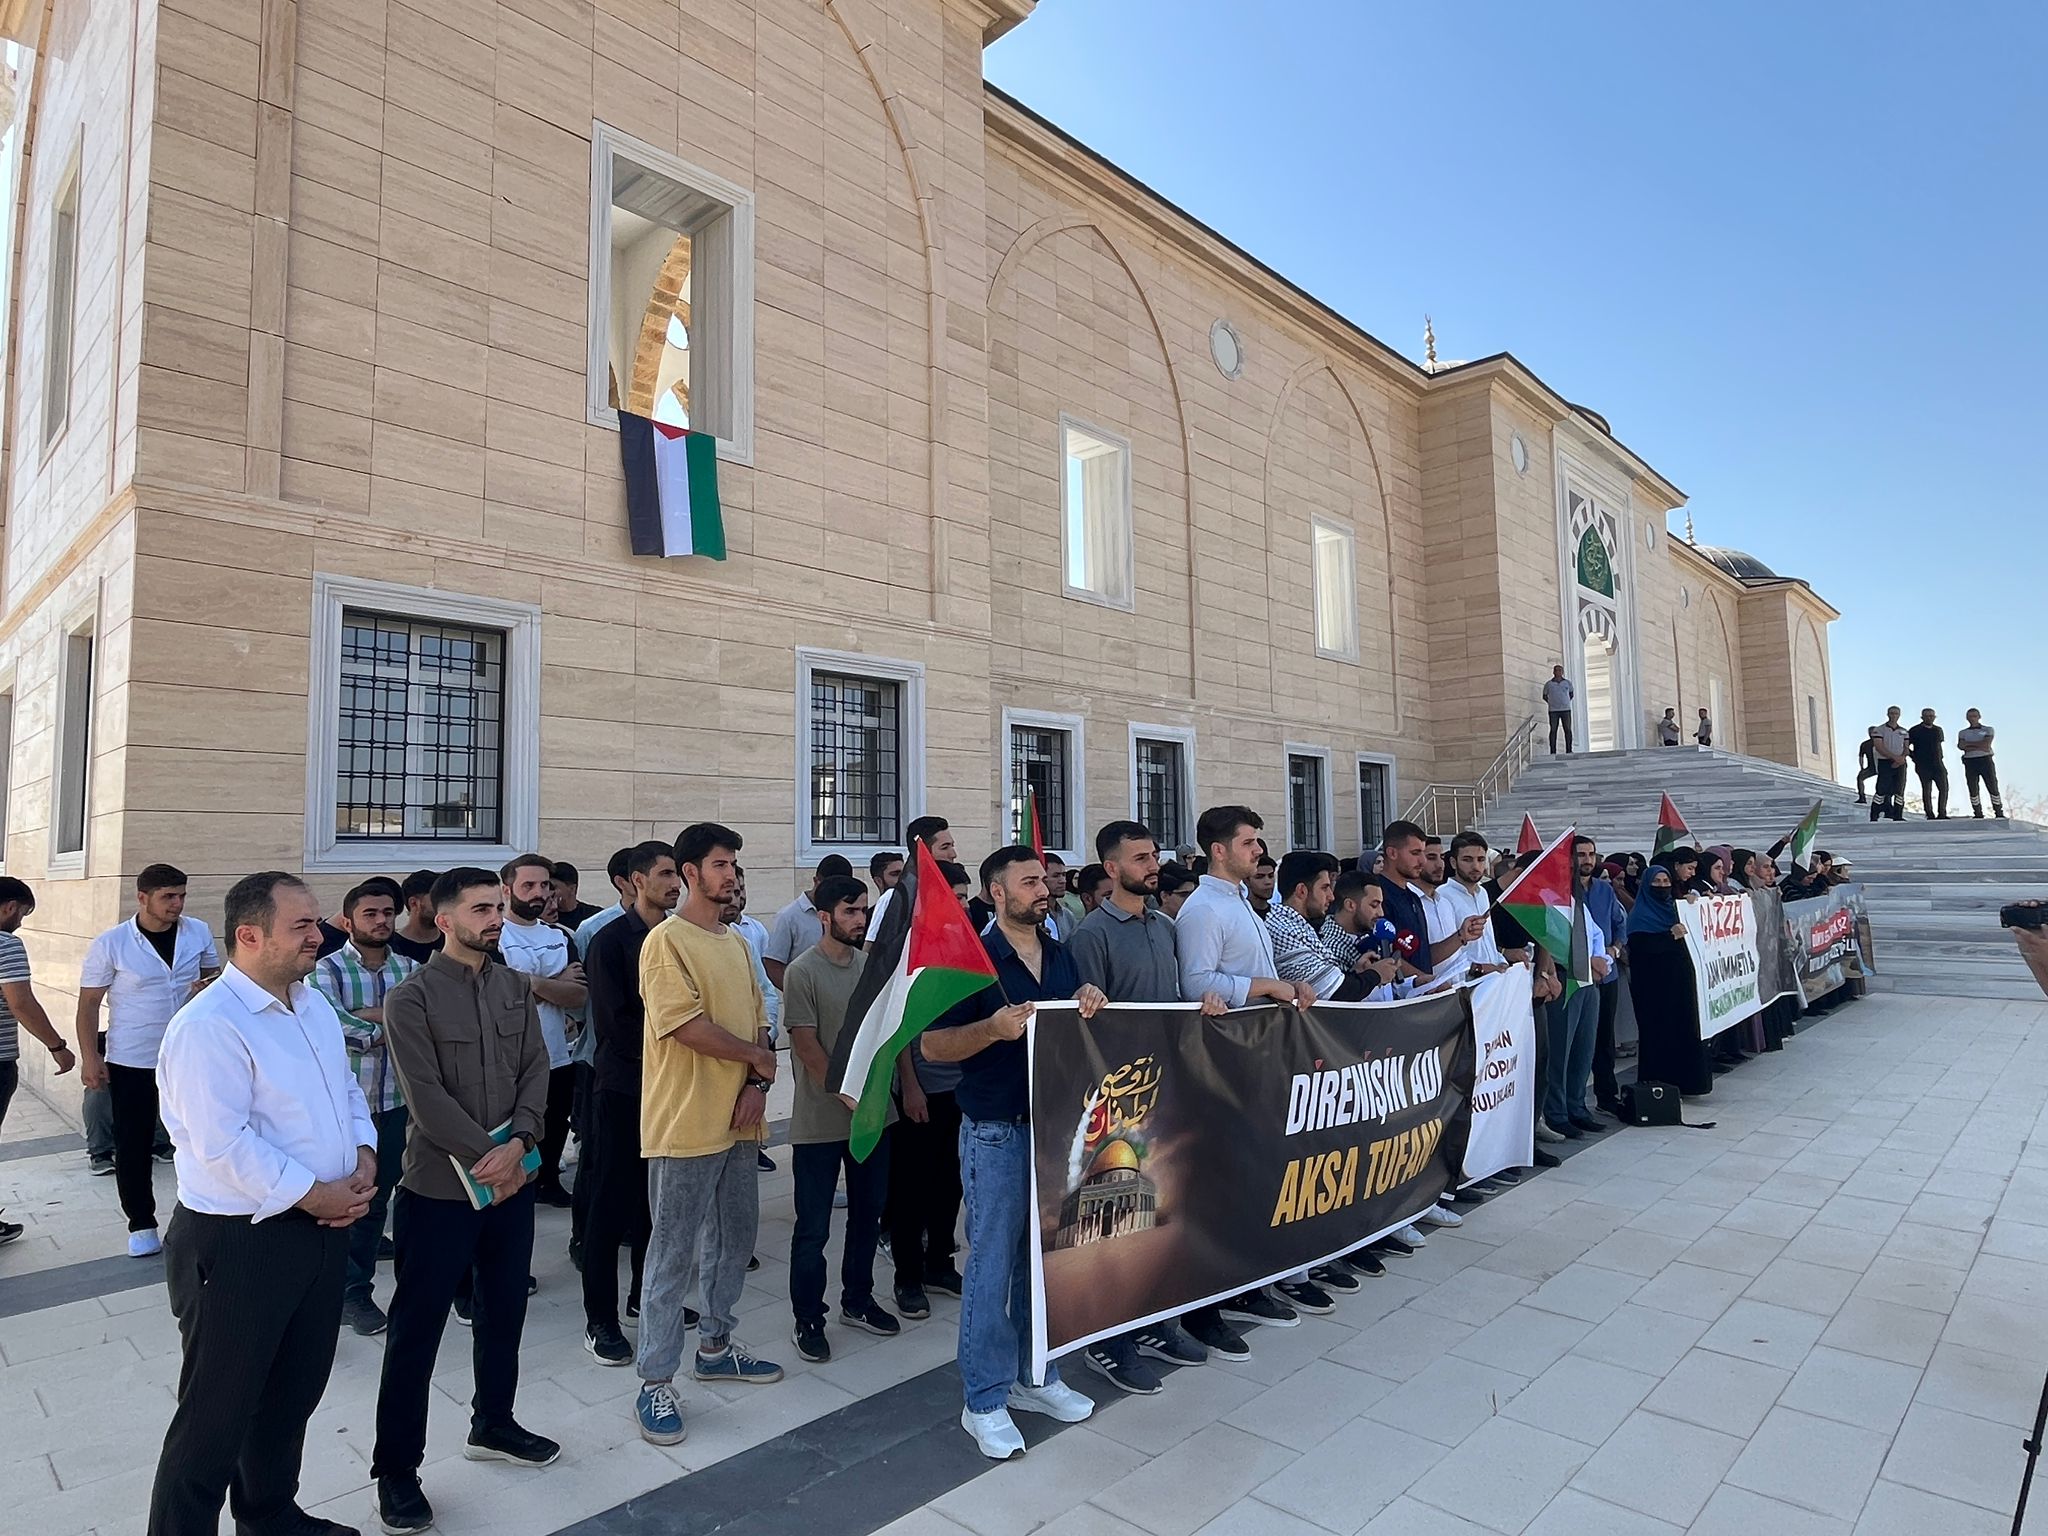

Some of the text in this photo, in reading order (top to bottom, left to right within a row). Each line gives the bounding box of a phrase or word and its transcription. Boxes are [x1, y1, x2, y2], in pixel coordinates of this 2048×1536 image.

[1285, 1047, 1442, 1136] DİRENİŞİN ADI
[1270, 1146, 1360, 1227] AKSA
